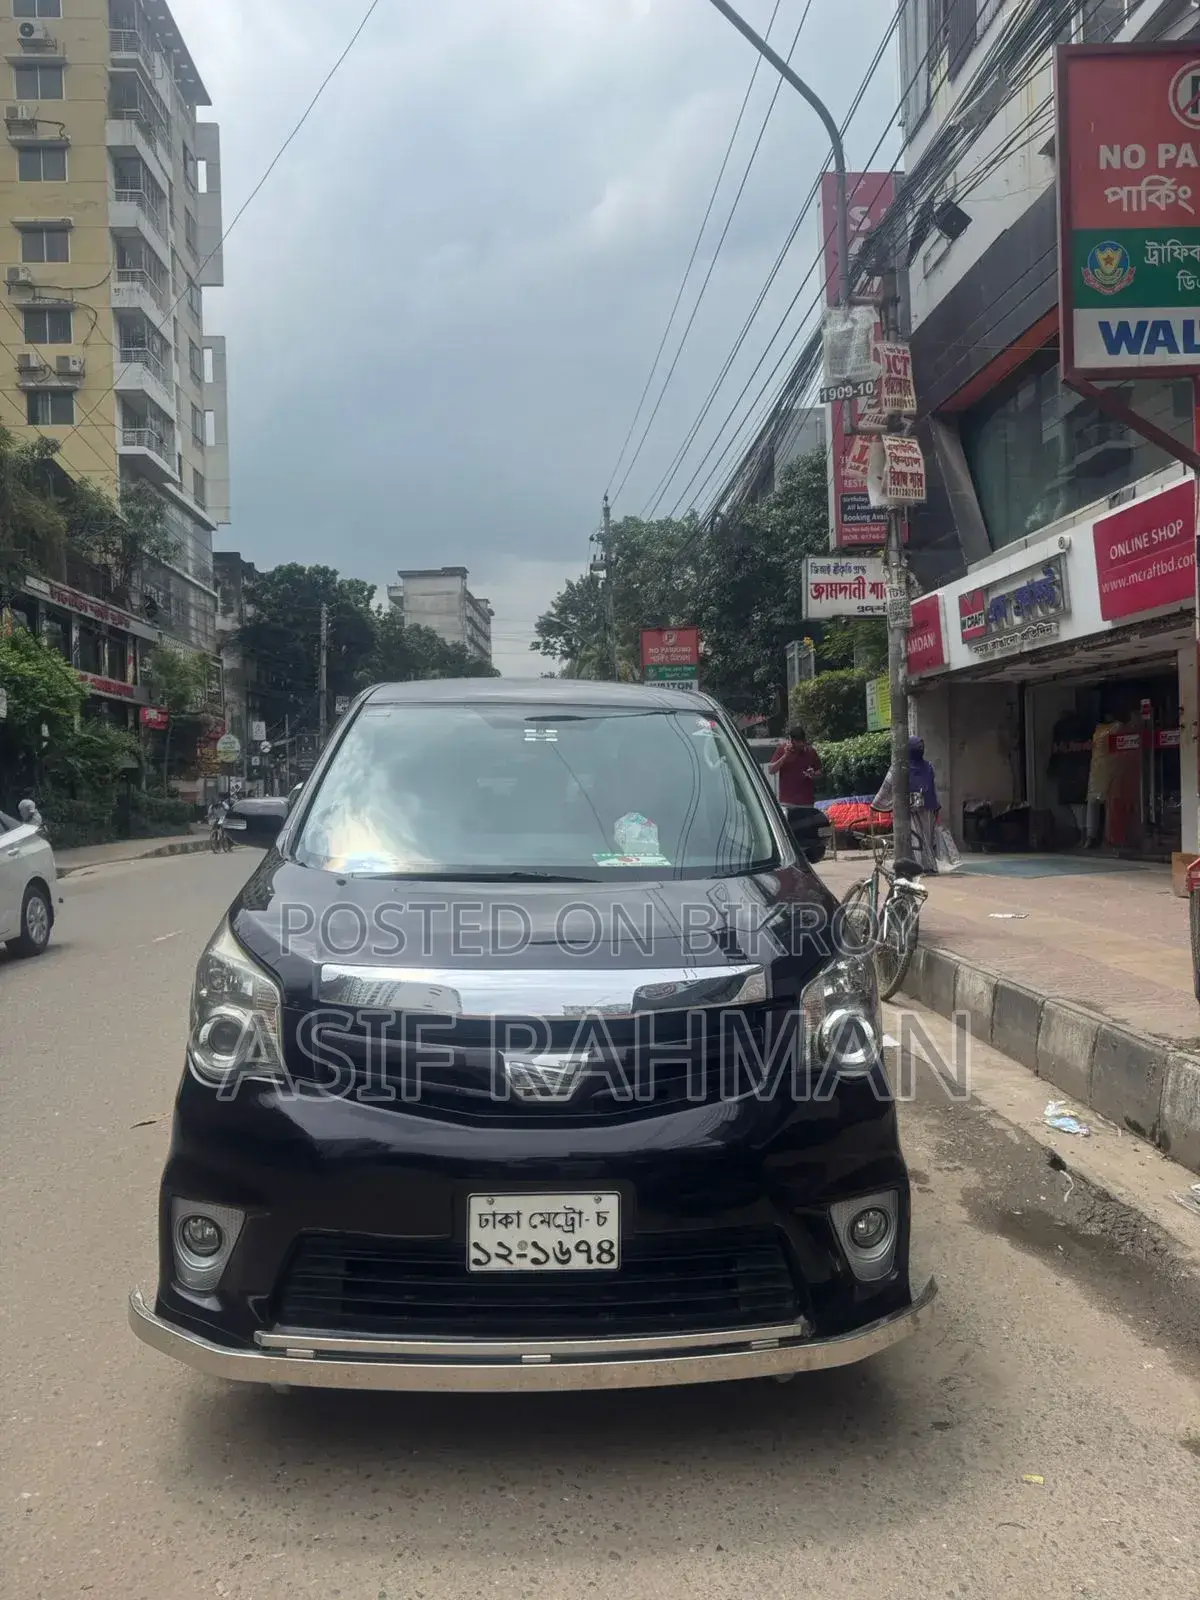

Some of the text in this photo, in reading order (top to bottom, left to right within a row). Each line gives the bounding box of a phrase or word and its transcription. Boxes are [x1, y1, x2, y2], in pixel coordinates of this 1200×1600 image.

[1099, 143, 1200, 170] NO PA
[1103, 175, 1195, 214] পার্কিং
[1098, 320, 1200, 355] WAL
[843, 479, 868, 488] RESTA
[843, 513, 871, 522] Booking
[1109, 519, 1184, 560] ONLINE SHOP
[810, 576, 888, 604] জামদানী শা
[477, 1210, 522, 1230] ঢাকা
[471, 1239, 616, 1266] ১২-১৬৭৪
